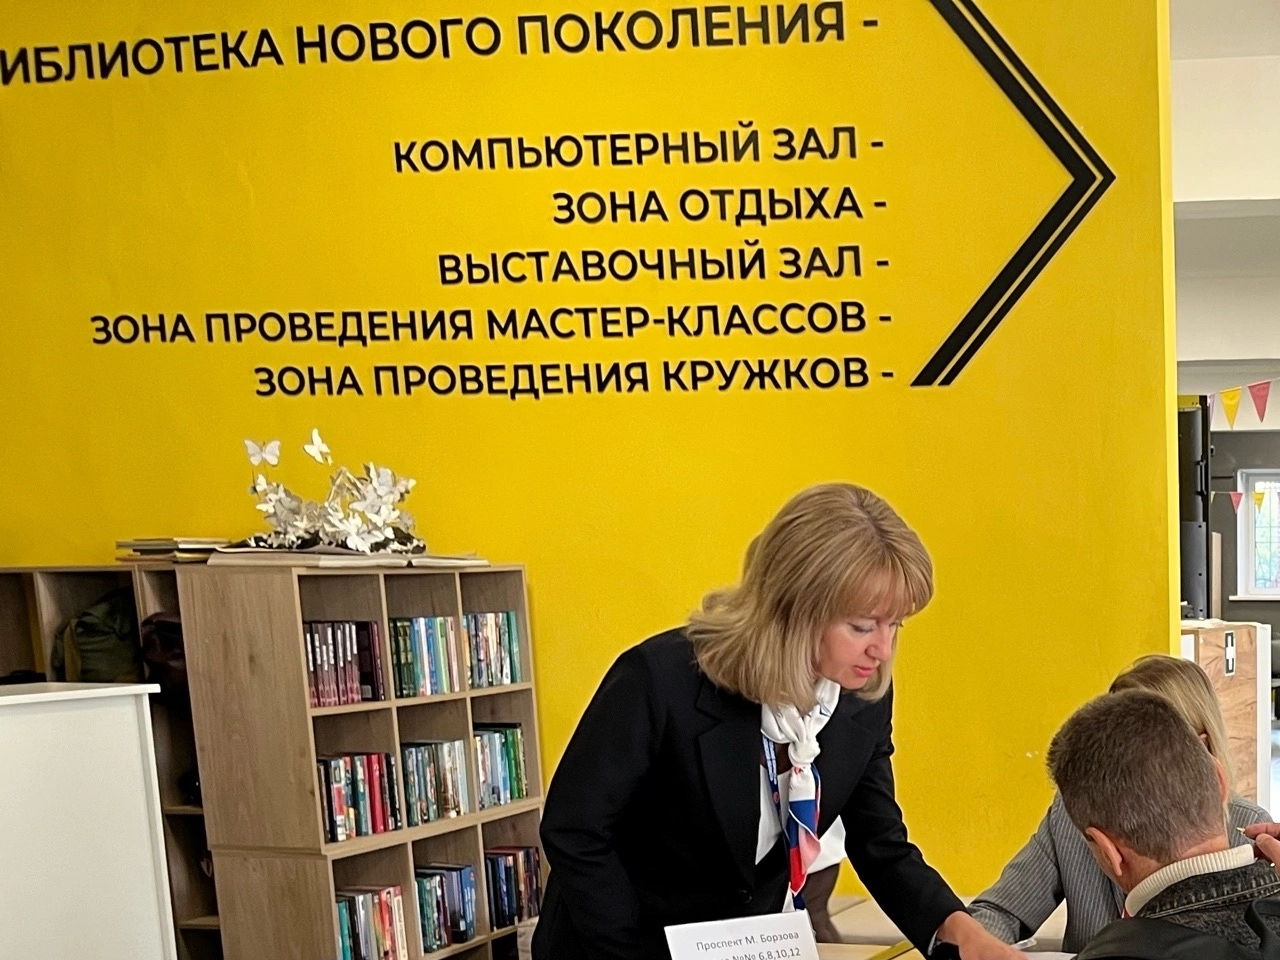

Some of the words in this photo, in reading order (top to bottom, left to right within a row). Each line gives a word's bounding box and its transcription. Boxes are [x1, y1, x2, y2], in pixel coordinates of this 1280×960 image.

[295, 16, 502, 65] НОВОГО
[517, 1, 845, 55] ПОКОЛЕНИЯ
[394, 120, 761, 174] КОМПЬЮТЕРНЫЙ
[772, 126, 858, 161] ЗАЛ
[551, 189, 669, 225] ЗОНА
[678, 186, 864, 228] ОТДЫХА
[438, 239, 766, 286] ВЫСТАВОЧНЫЙ
[778, 245, 863, 280] ЗАЛ
[90, 313, 196, 346] ЗОНА
[205, 309, 474, 348] ПРОВЕДЕНИЯ
[486, 301, 867, 340] МАСТЕР-КЛАССОВ
[254, 366, 364, 397] ЗОНА
[373, 361, 649, 400] ПРОВЕДЕНИЯ
[662, 357, 870, 392] КРУЖКОВ
[696, 938, 743, 952] Проспект
[744, 935, 759, 945] М.
[759, 931, 800, 944] Борзова
